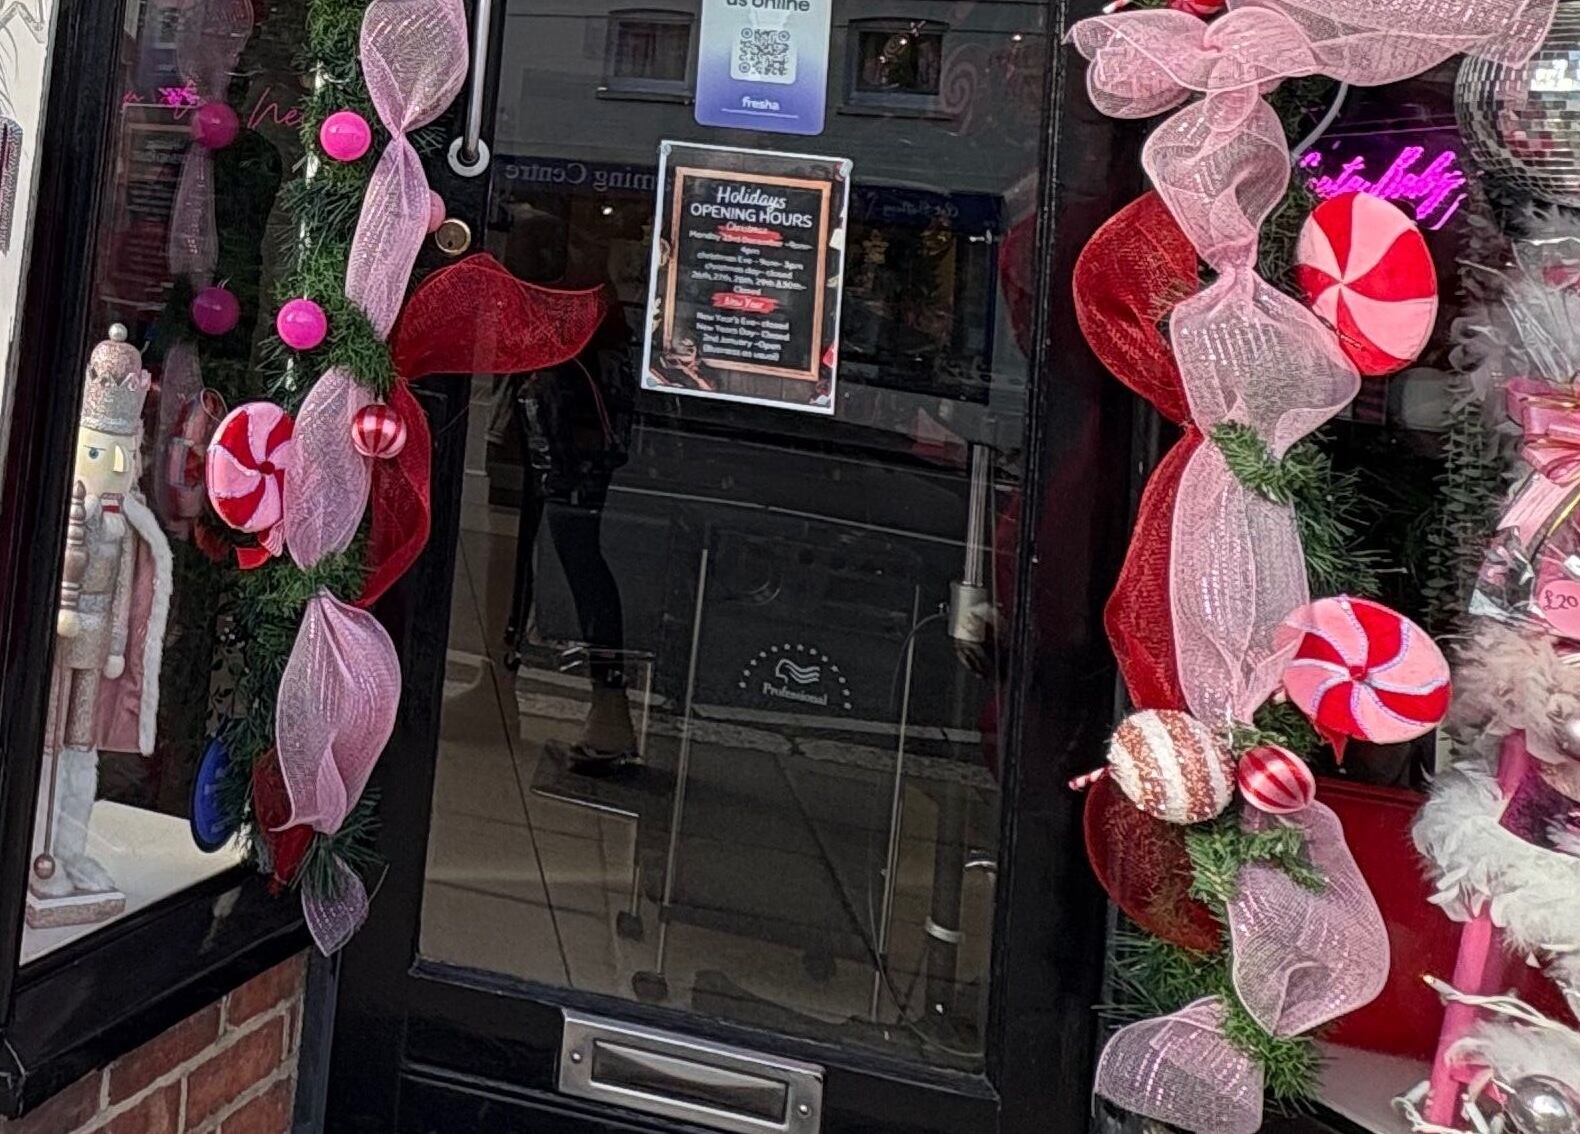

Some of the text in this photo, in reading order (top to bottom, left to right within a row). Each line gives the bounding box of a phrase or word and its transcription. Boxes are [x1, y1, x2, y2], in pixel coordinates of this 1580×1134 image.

[741, 96, 780, 112] fresha
[716, 185, 787, 213] Holidays
[690, 202, 813, 228] OPENING HOURS
